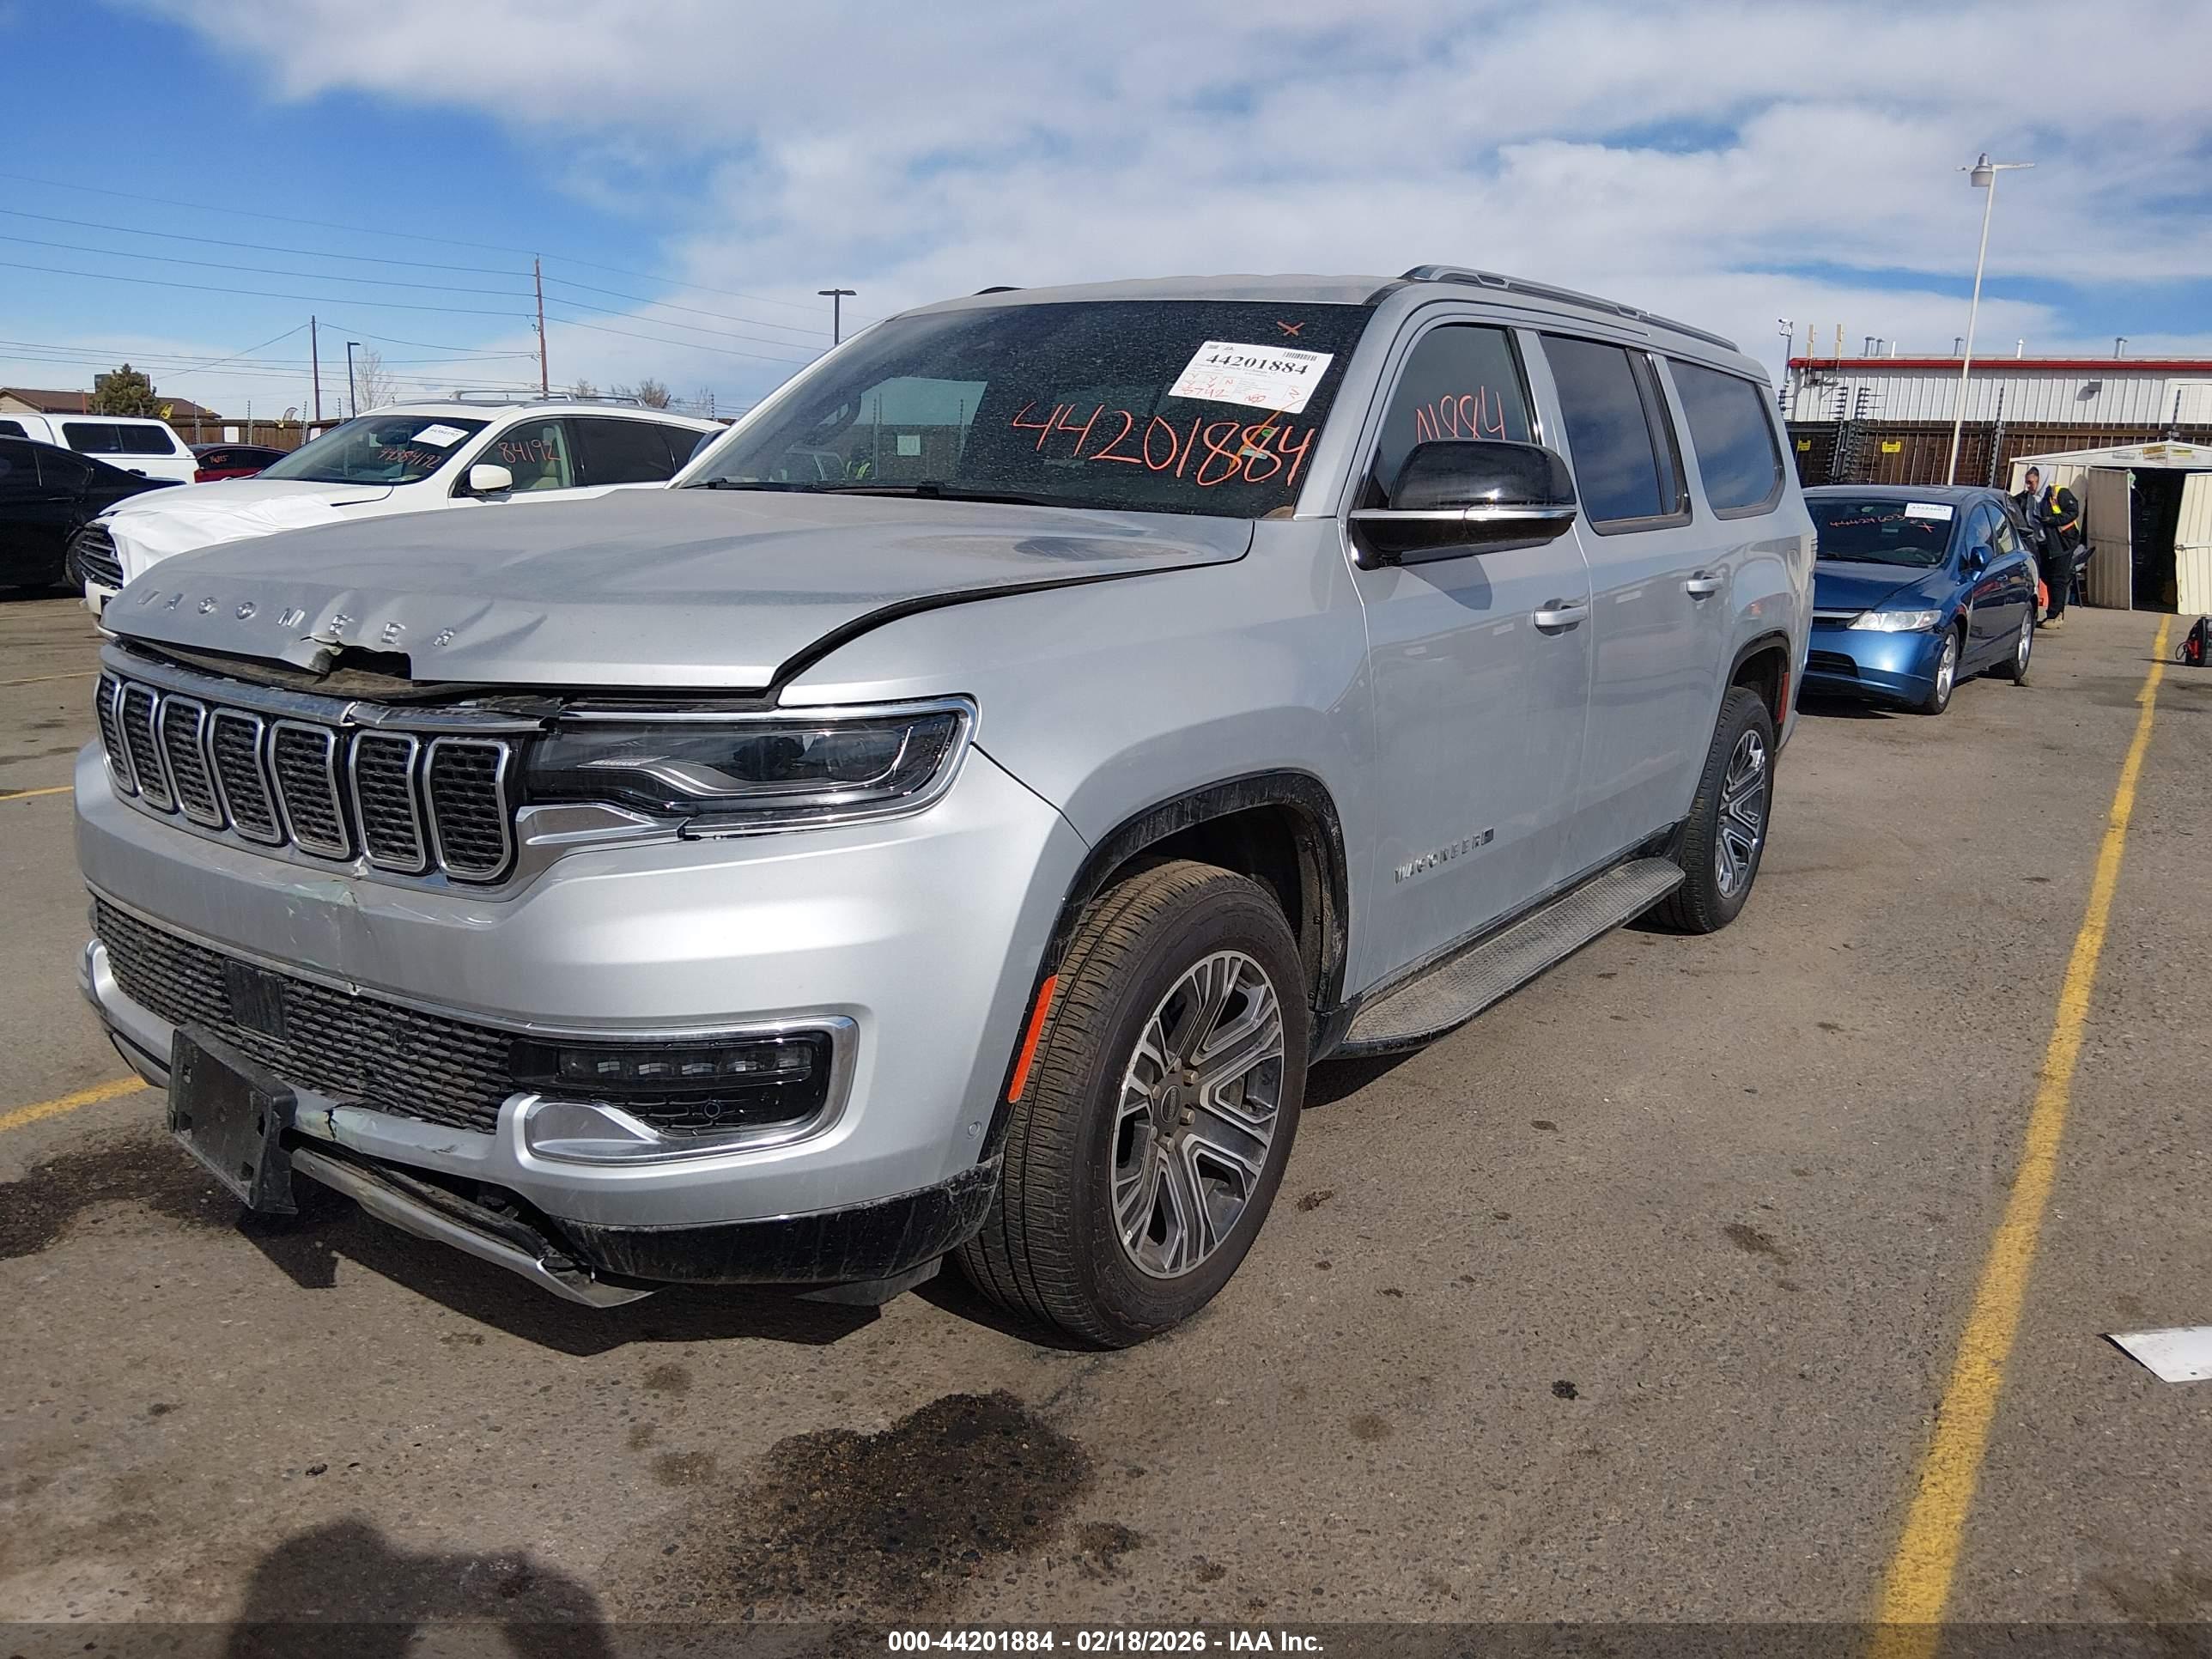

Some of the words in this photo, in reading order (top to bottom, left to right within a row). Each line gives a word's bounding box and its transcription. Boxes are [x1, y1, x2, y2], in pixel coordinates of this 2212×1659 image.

[1206, 354, 1309, 374] 44201884
[498, 440, 562, 463] 84192
[1012, 401, 1316, 487] 44201884
